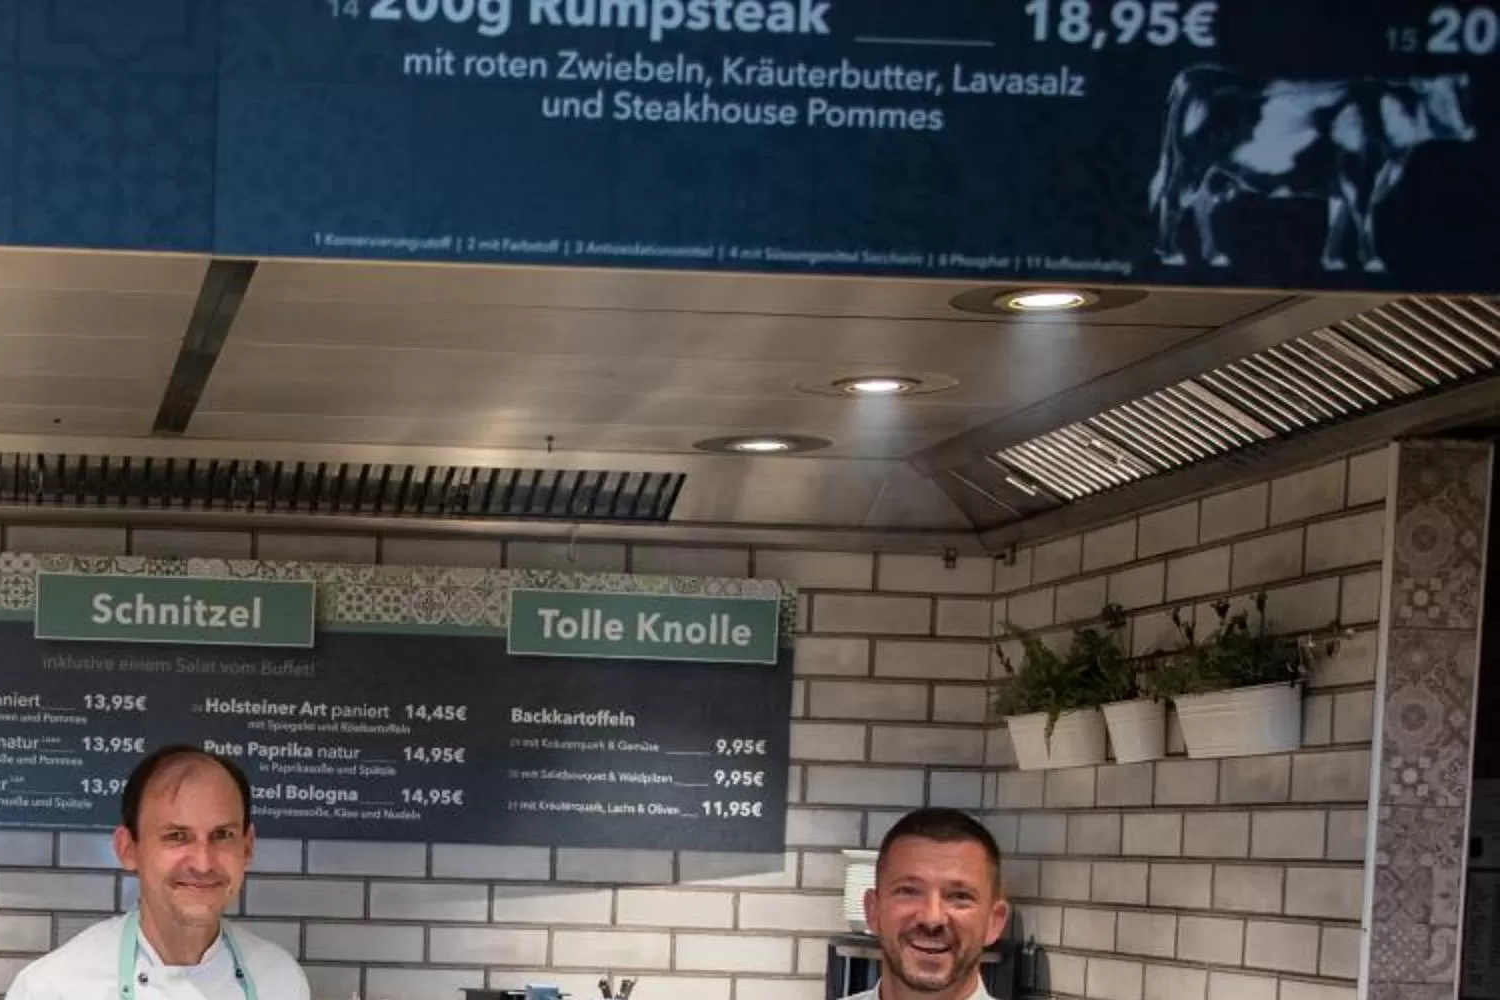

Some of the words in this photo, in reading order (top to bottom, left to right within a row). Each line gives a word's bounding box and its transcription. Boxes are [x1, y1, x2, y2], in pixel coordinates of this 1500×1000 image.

[529, 0, 831, 42] Rumpsteak
[1024, 0, 1218, 50] 18,95€
[403, 47, 455, 77] mit
[463, 51, 548, 79] roten
[557, 50, 714, 89] Zwiebeln,
[722, 56, 945, 96] Kräuterbutter,
[952, 62, 1086, 97] Lavasalz
[542, 88, 604, 119] und
[612, 90, 798, 126] Steakhouse
[806, 97, 946, 131] Pommes
[90, 593, 262, 630] Schnitzel
[537, 608, 625, 641] Tolle
[636, 611, 753, 647] Knolle
[83, 693, 148, 712] 13,95€
[205, 697, 297, 715] Holsteiner
[300, 700, 327, 717] Art
[331, 703, 389, 721] paniert
[405, 703, 467, 722] 14,45€
[511, 707, 636, 727] Backkartoffeln
[82, 735, 145, 753] 13,95€
[203, 740, 243, 756] Pute
[247, 741, 313, 761] Paprika
[317, 745, 361, 760] natur
[715, 738, 767, 756] 9,95€
[403, 745, 465, 764] 14,95€
[714, 768, 765, 788] 9,95€
[285, 784, 359, 805] Bologna
[401, 787, 464, 806] 14,95€
[701, 801, 763, 819] 11,95€
